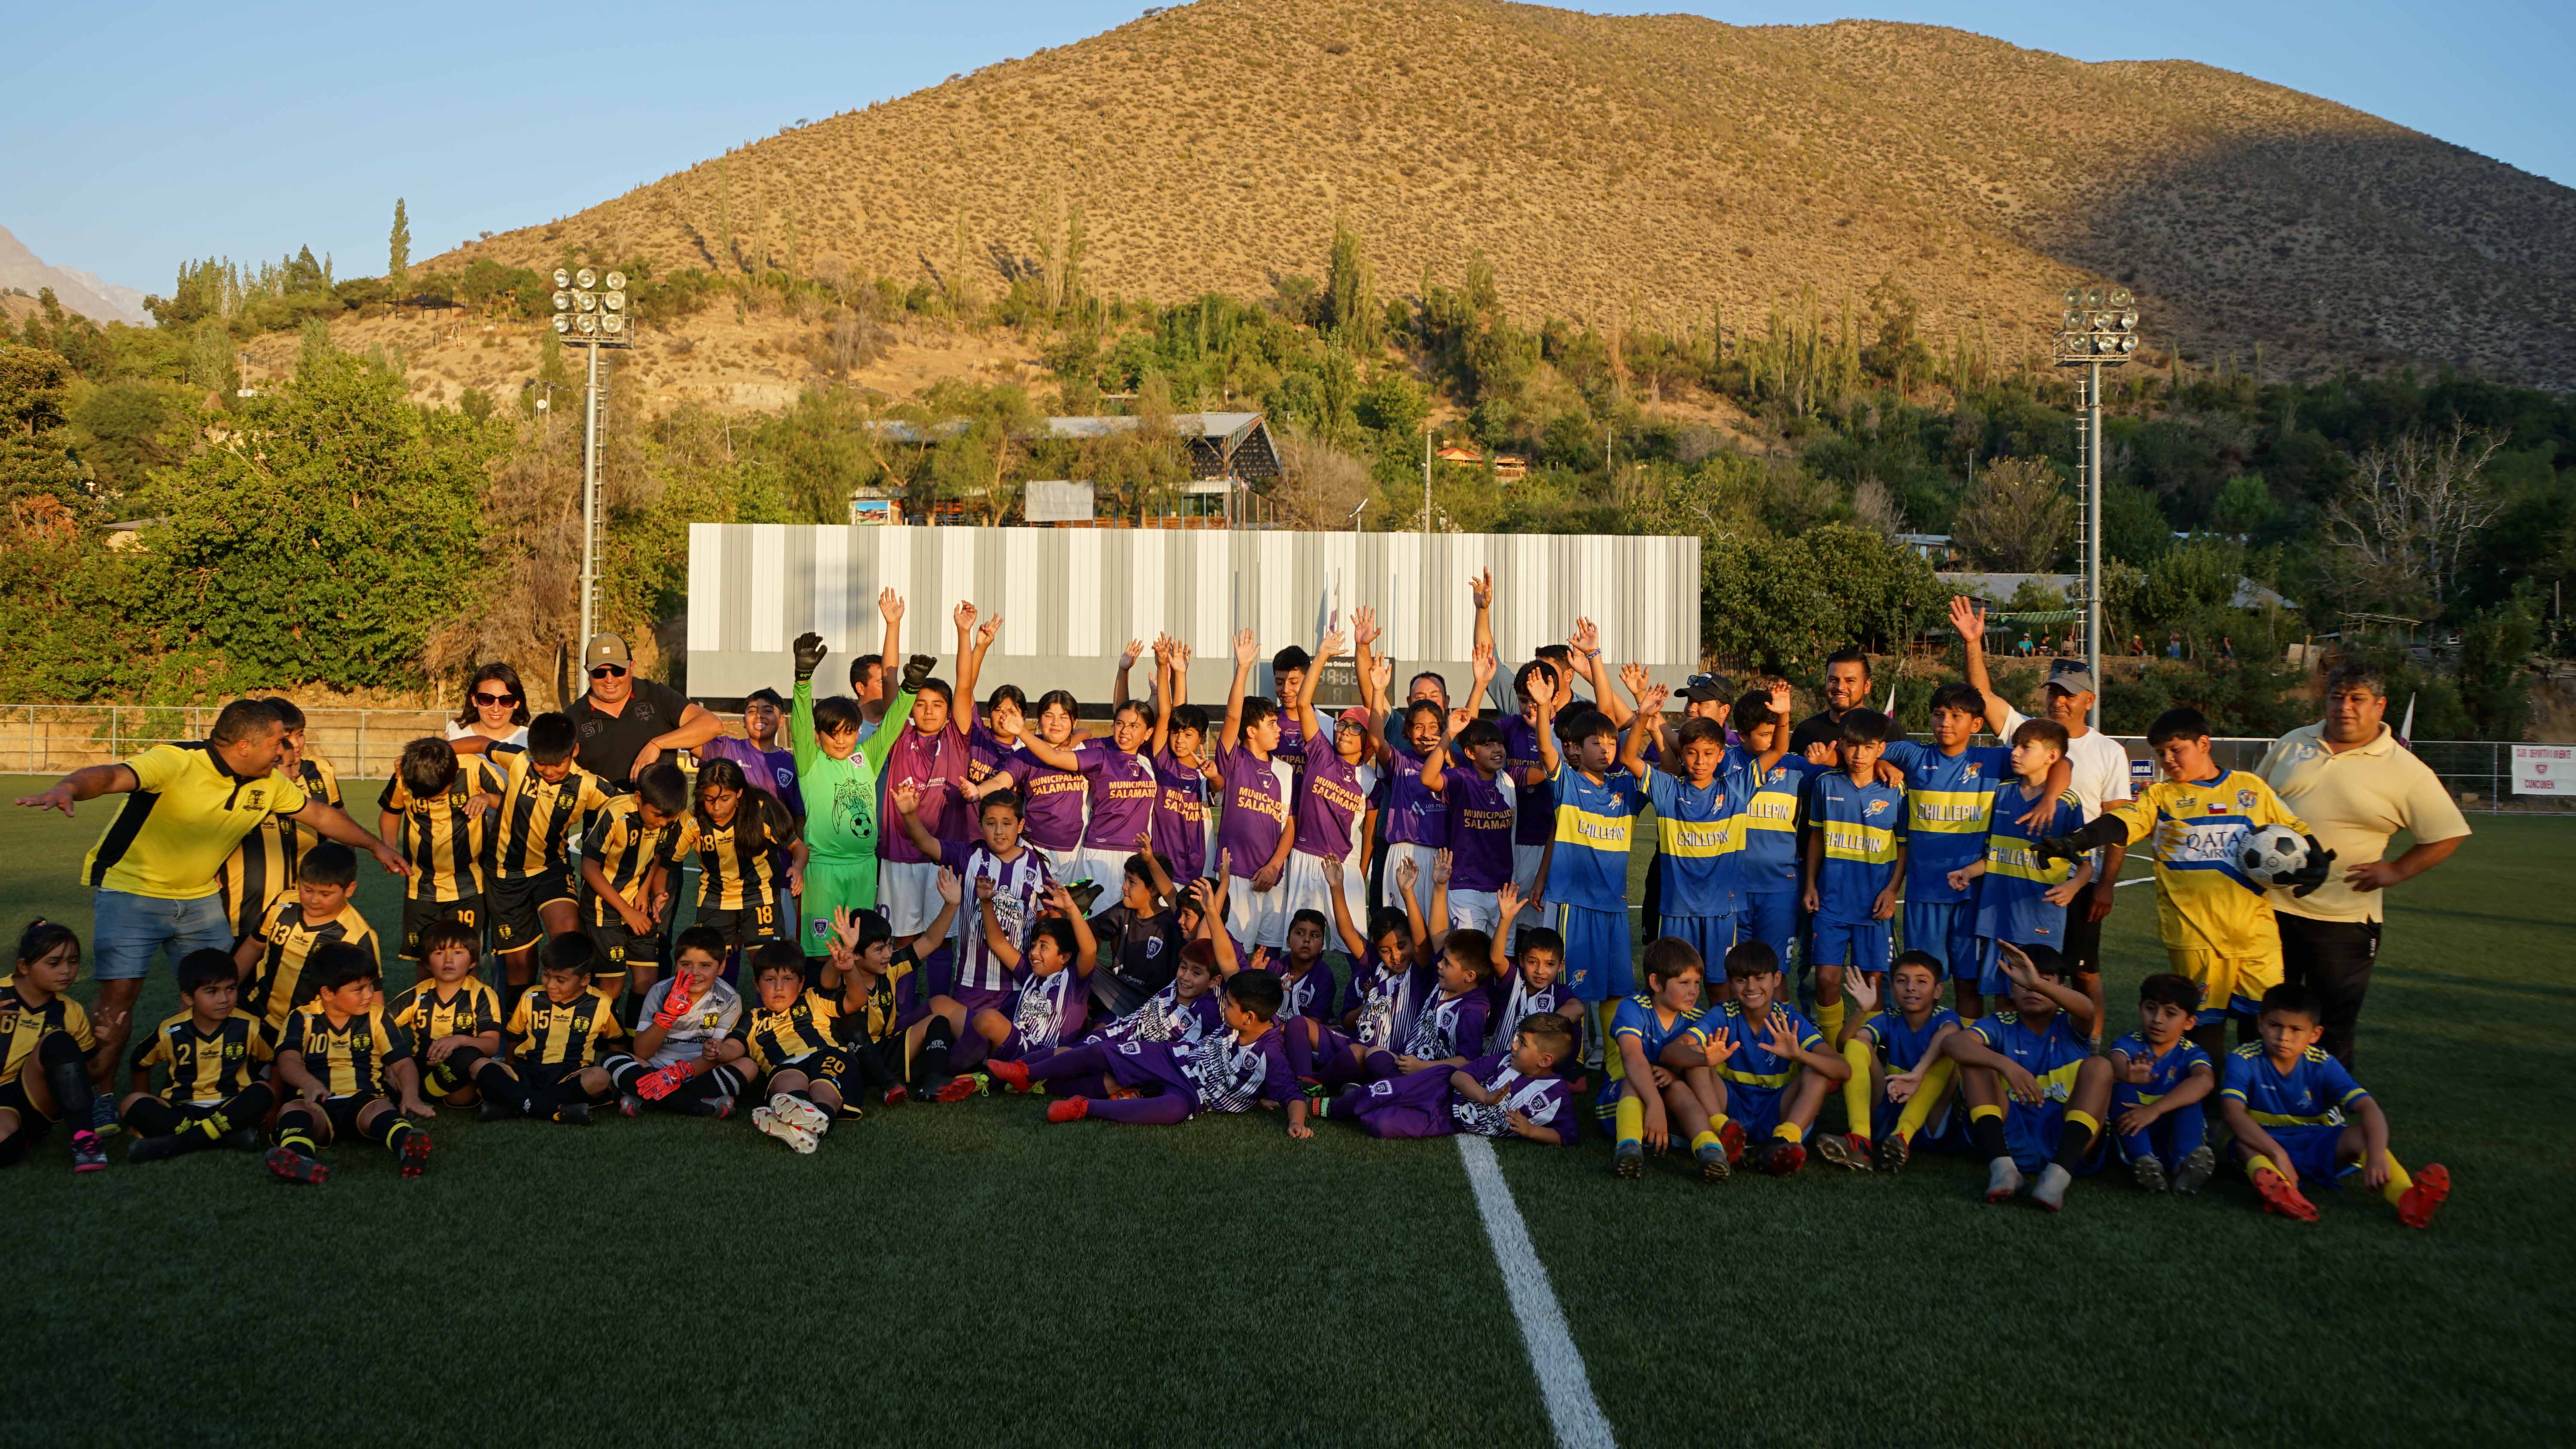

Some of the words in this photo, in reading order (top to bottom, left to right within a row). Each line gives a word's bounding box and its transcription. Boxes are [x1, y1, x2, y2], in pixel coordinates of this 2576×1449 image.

[581, 719, 603, 737] 57
[522, 775, 538, 798] 12
[1109, 780, 1156, 789] MUNICIPALID
[1109, 788, 1156, 799] SALAMANC
[1464, 809, 1516, 819] MUNICIPALID
[1917, 803, 1982, 822] CHILLEPIN
[629, 829, 639, 846] 8
[700, 834, 715, 852] 18
[2201, 848, 2239, 859] AIRW
[457, 909, 475, 928] 19
[755, 905, 773, 925] 18
[270, 921, 291, 945] 13
[416, 1009, 428, 1029] 5
[532, 1009, 550, 1030] 15
[309, 1033, 328, 1054] 10
[177, 1043, 191, 1066] 2
[821, 1055, 846, 1074] 20
